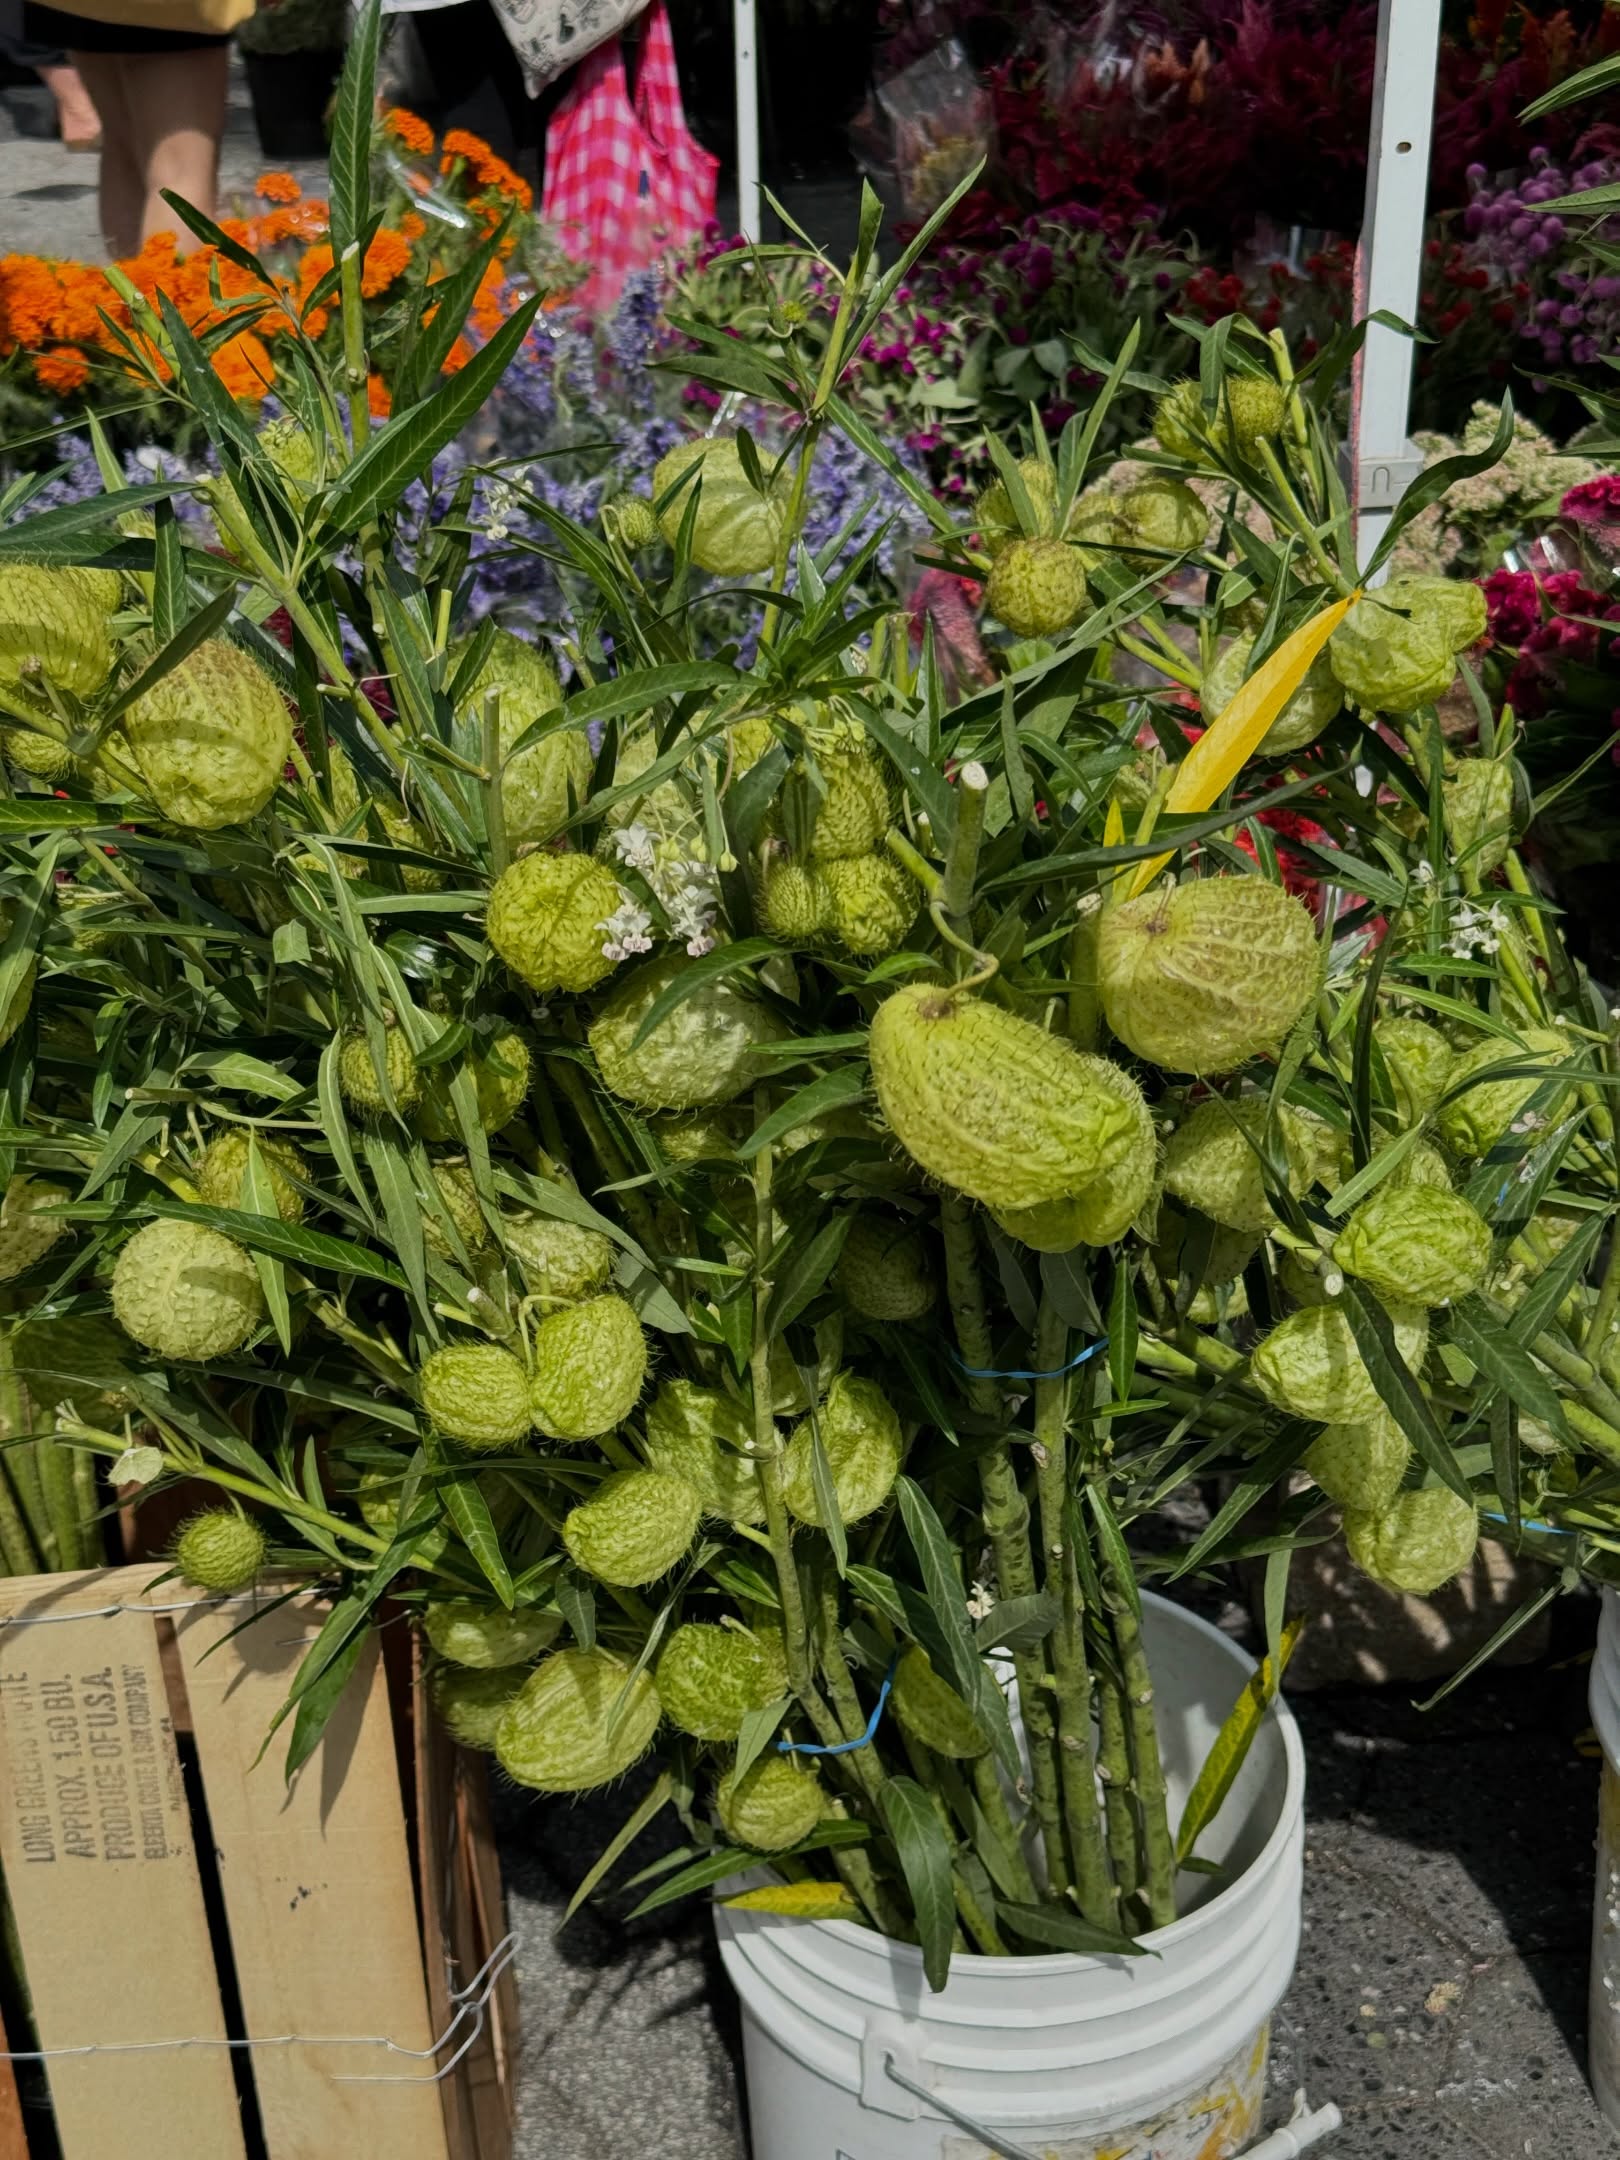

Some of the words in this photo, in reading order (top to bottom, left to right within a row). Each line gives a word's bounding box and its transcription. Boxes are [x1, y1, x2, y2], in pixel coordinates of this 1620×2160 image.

[40, 1673, 76, 1710] BU.
[121, 1664, 151, 1726] COMPANY
[46, 1715, 82, 1760] 1.50
[88, 1731, 122, 1757] OF
[129, 1727, 155, 1751] BOX
[134, 1766, 161, 1805] CRATE
[56, 1766, 98, 1858] APPROX.
[93, 1764, 136, 1861] PRODUCE
[19, 1815, 56, 1862] LONG
